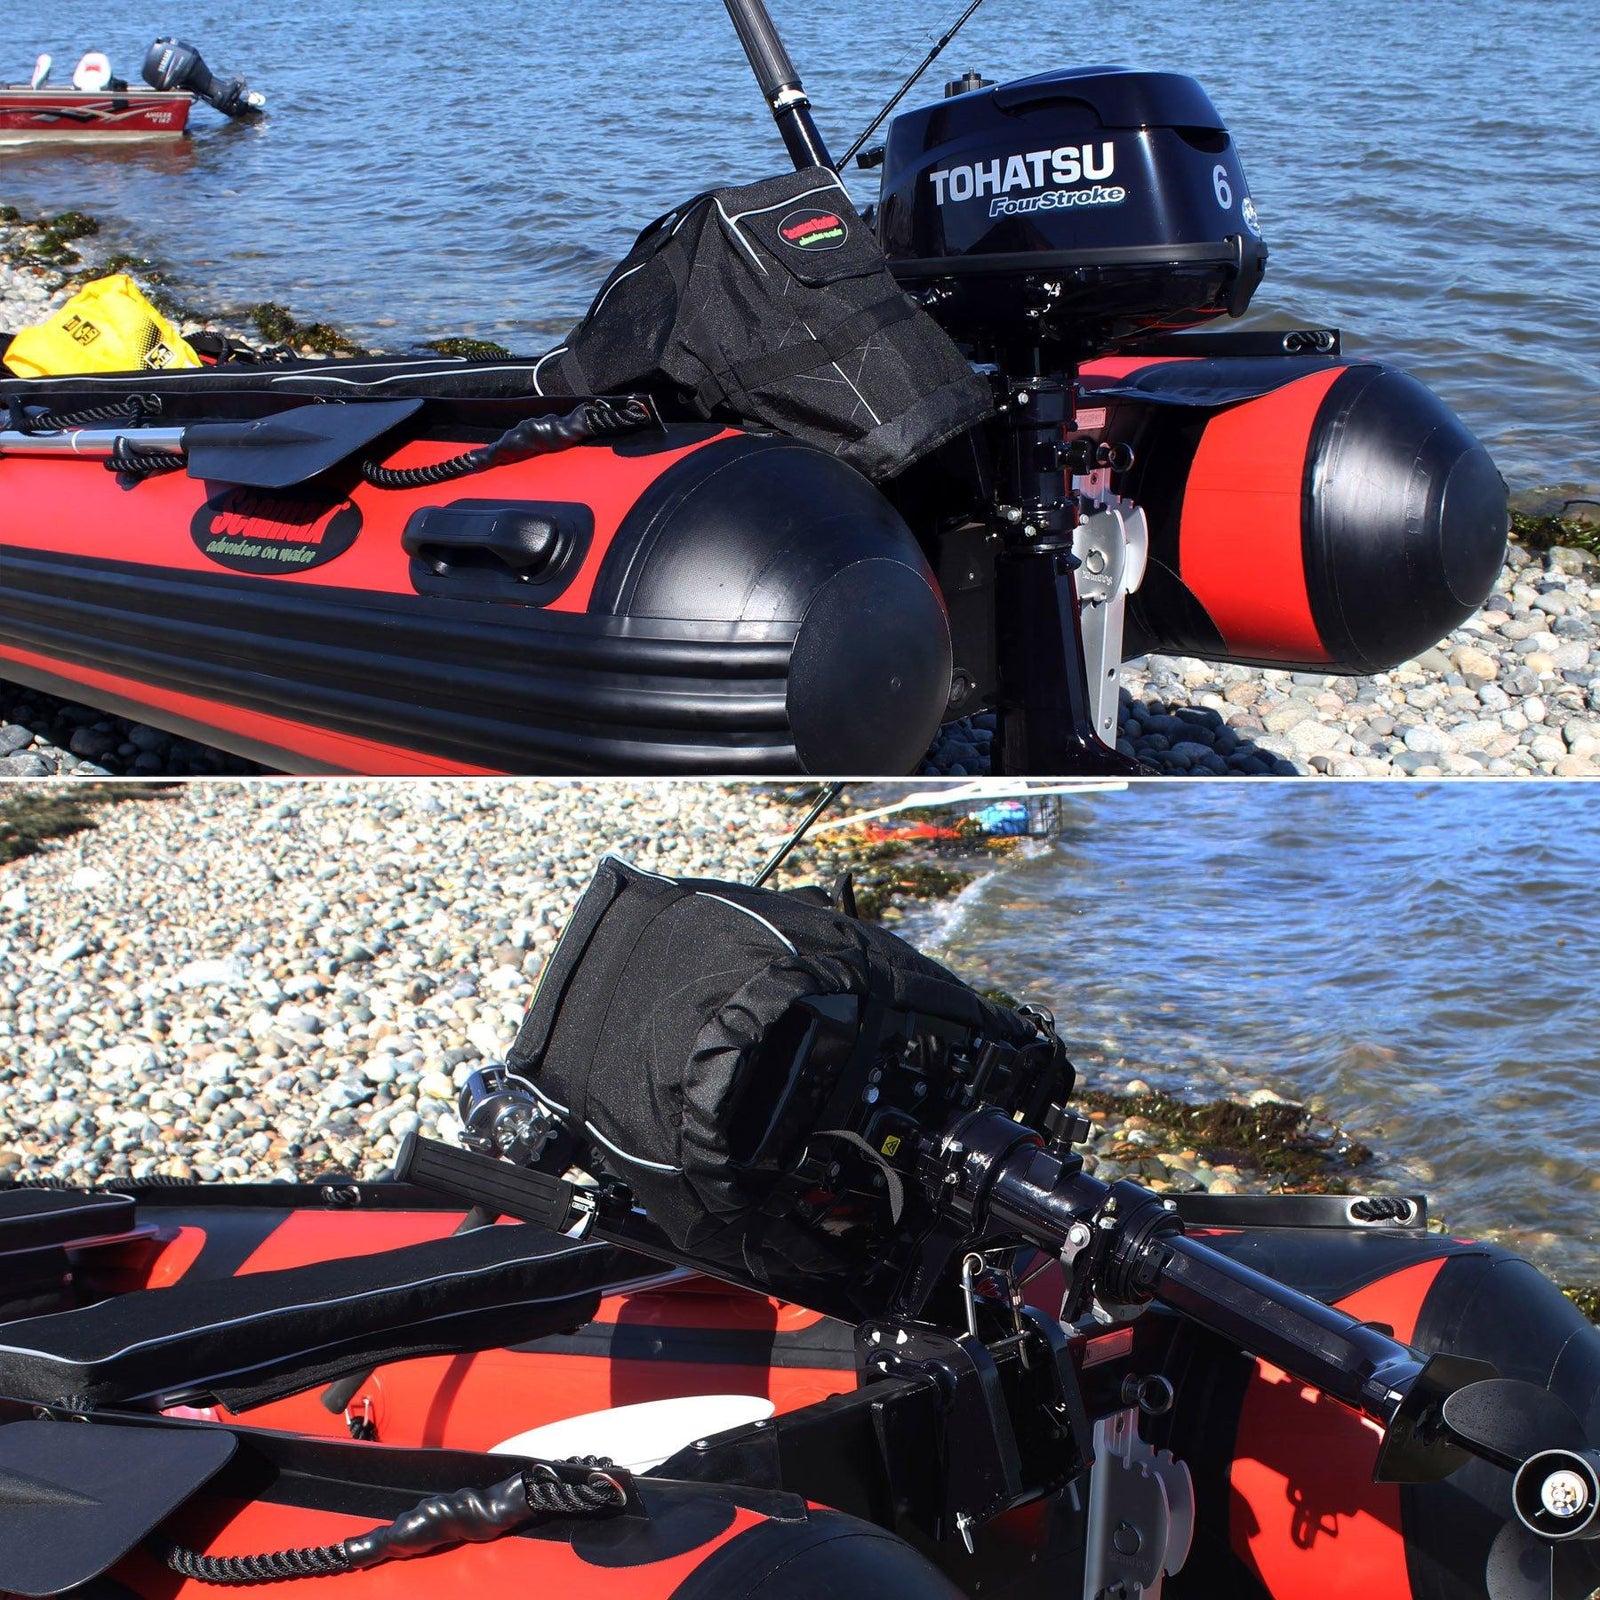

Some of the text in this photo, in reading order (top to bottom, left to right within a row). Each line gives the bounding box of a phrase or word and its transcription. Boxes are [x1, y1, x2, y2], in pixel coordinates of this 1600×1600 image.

[930, 142, 1114, 205] TOHATSU
[1213, 164, 1232, 210] 6
[989, 186, 1125, 217] FourStroke
[206, 536, 262, 557] adventure
[279, 545, 316, 563] water
